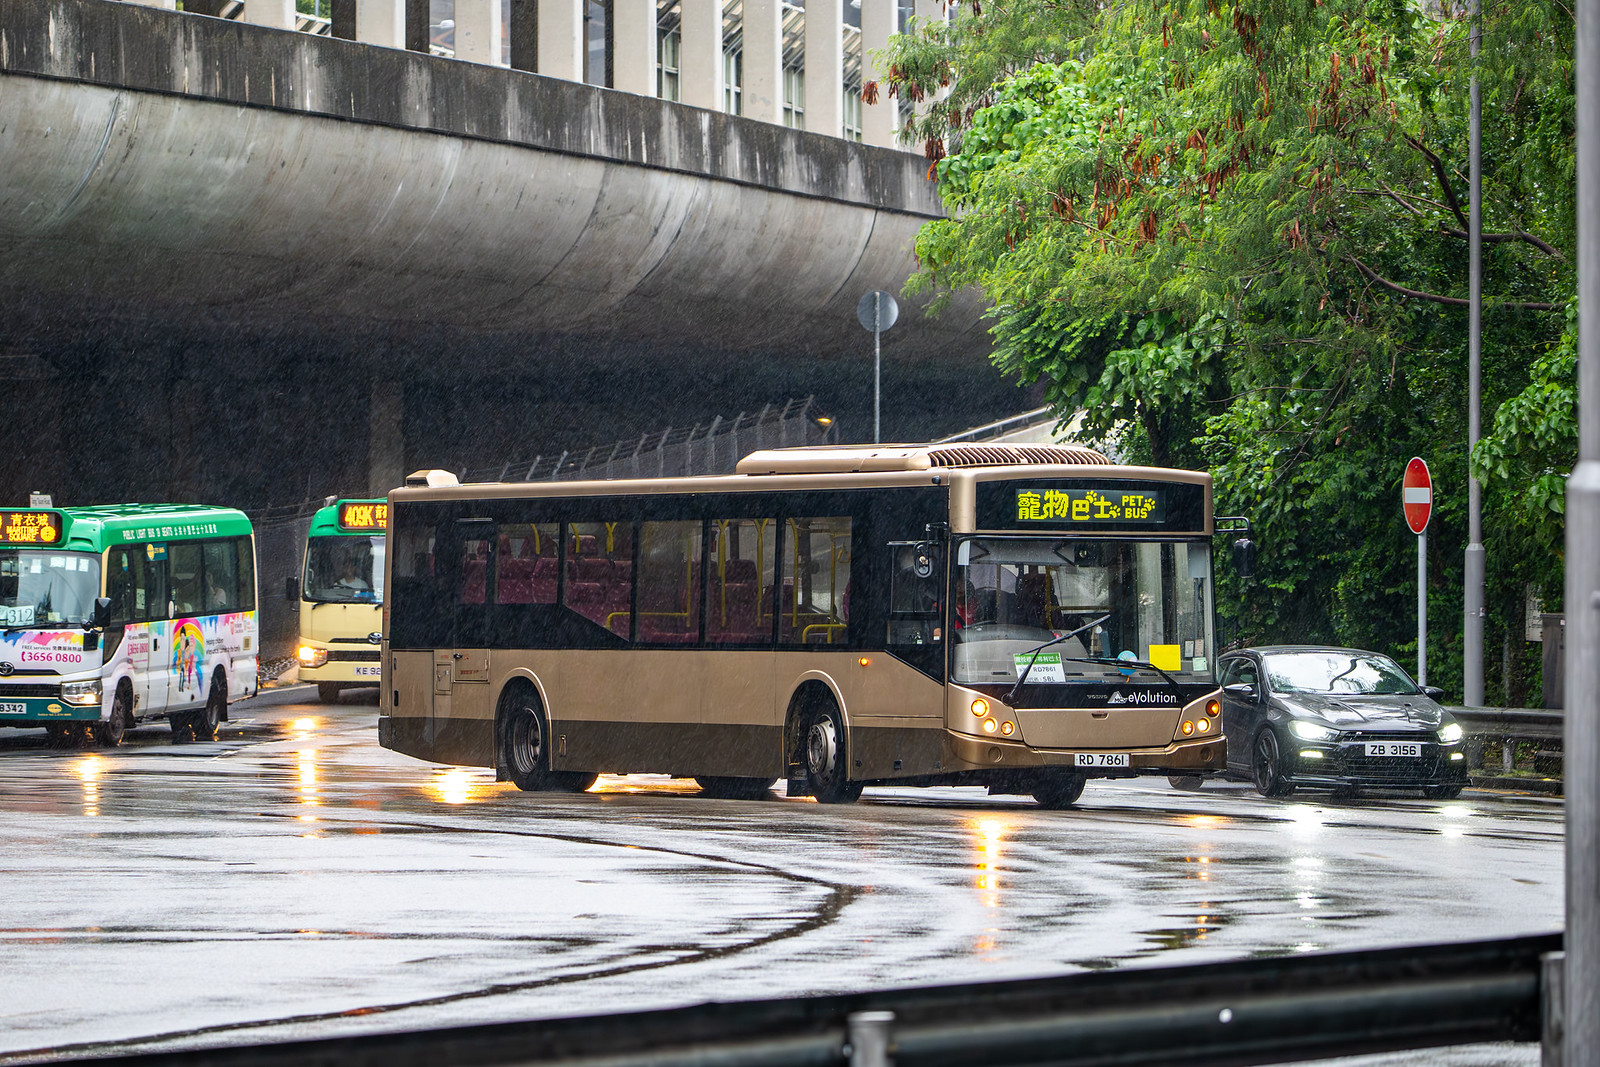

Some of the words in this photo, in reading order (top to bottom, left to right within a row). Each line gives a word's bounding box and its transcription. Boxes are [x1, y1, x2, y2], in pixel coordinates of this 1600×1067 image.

[1017, 489, 1112, 520] 寵物巴士
[1122, 495, 1144, 507] PET
[345, 505, 374, 526] 409K
[1125, 507, 1148, 519] BUS
[10, 513, 49, 527] 青衣城
[6, 525, 39, 535] MARITIME
[8, 533, 37, 542] SQUARE
[8, 608, 34, 624] 312
[27, 651, 53, 662] 3656
[55, 653, 82, 663] 0800
[355, 667, 368, 675] KE
[369, 667, 381, 675] 92
[1128, 690, 1177, 705] eVolution
[0, 704, 24, 712] 8342
[1370, 745, 1386, 755] ZB
[1390, 745, 1416, 755] 3156
[1079, 755, 1094, 766] RD
[1099, 755, 1124, 766] 7861
